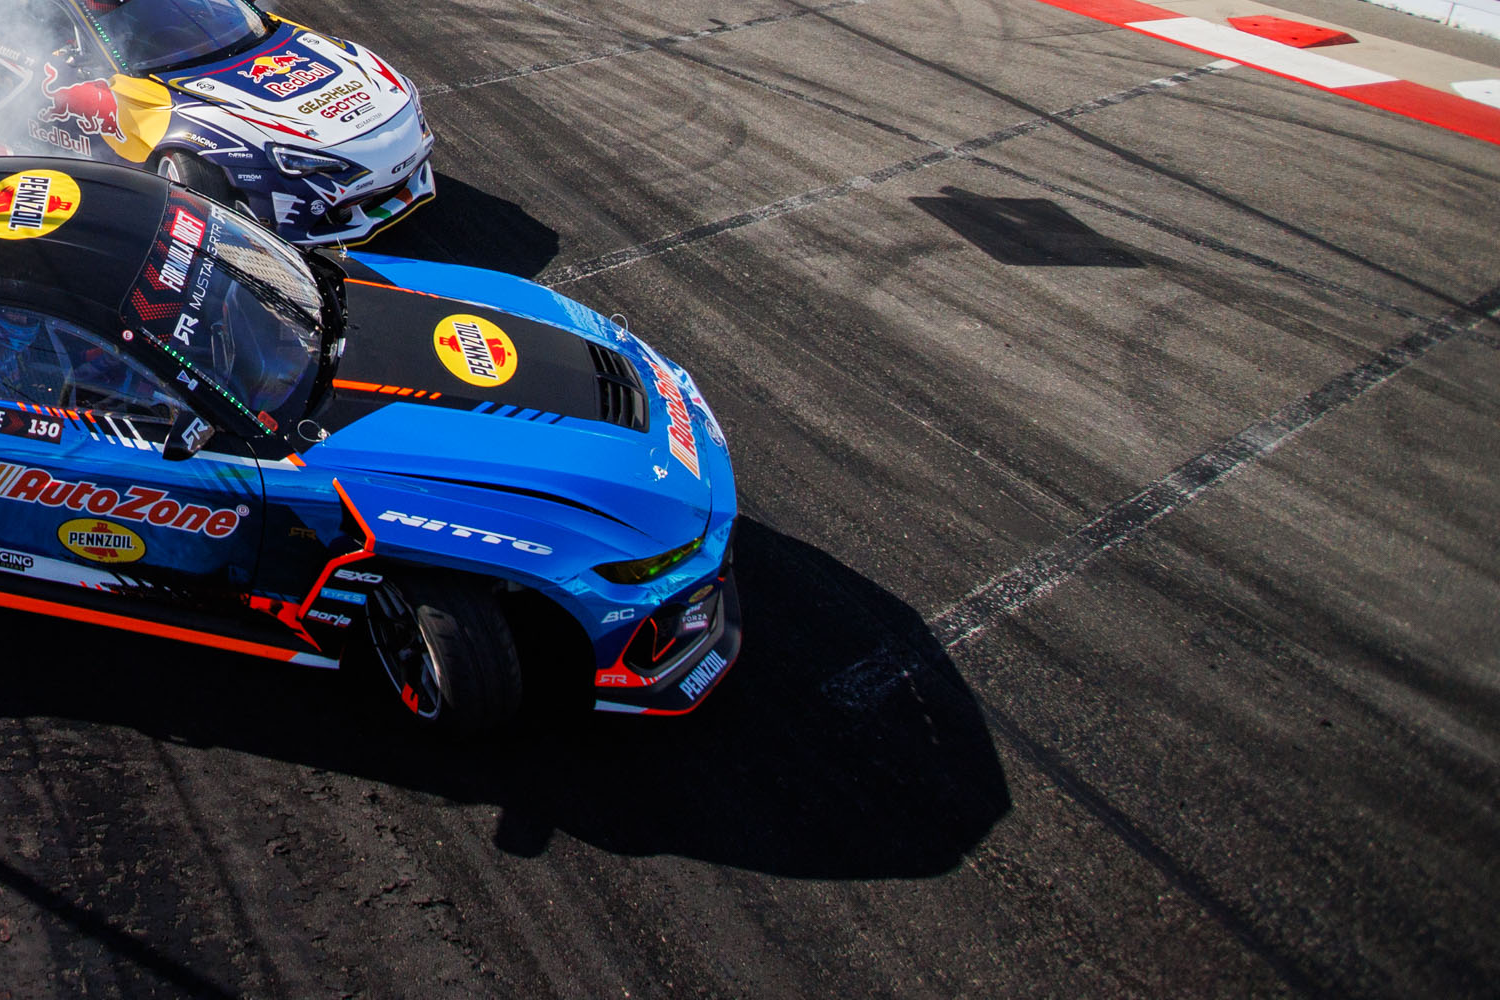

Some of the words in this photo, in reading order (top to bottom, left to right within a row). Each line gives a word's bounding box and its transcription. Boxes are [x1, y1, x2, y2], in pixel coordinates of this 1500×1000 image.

[297, 79, 364, 115] GEARHEAD
[320, 91, 371, 119] GROTTO
[190, 134, 217, 150] RACING
[9, 175, 52, 231] PENNZOIL
[158, 238, 195, 293] FORMULA
[177, 209, 207, 248] DRIFT
[189, 243, 218, 311] MUSTANG
[453, 322, 498, 378] PENNZOIL
[28, 418, 60, 438] 130
[7, 467, 239, 538] AutoZone
[68, 531, 133, 550] PENNZOIL
[377, 510, 553, 556] NITTO
[682, 613, 708, 623] FORZA
[678, 649, 728, 701] PENNZOIL
